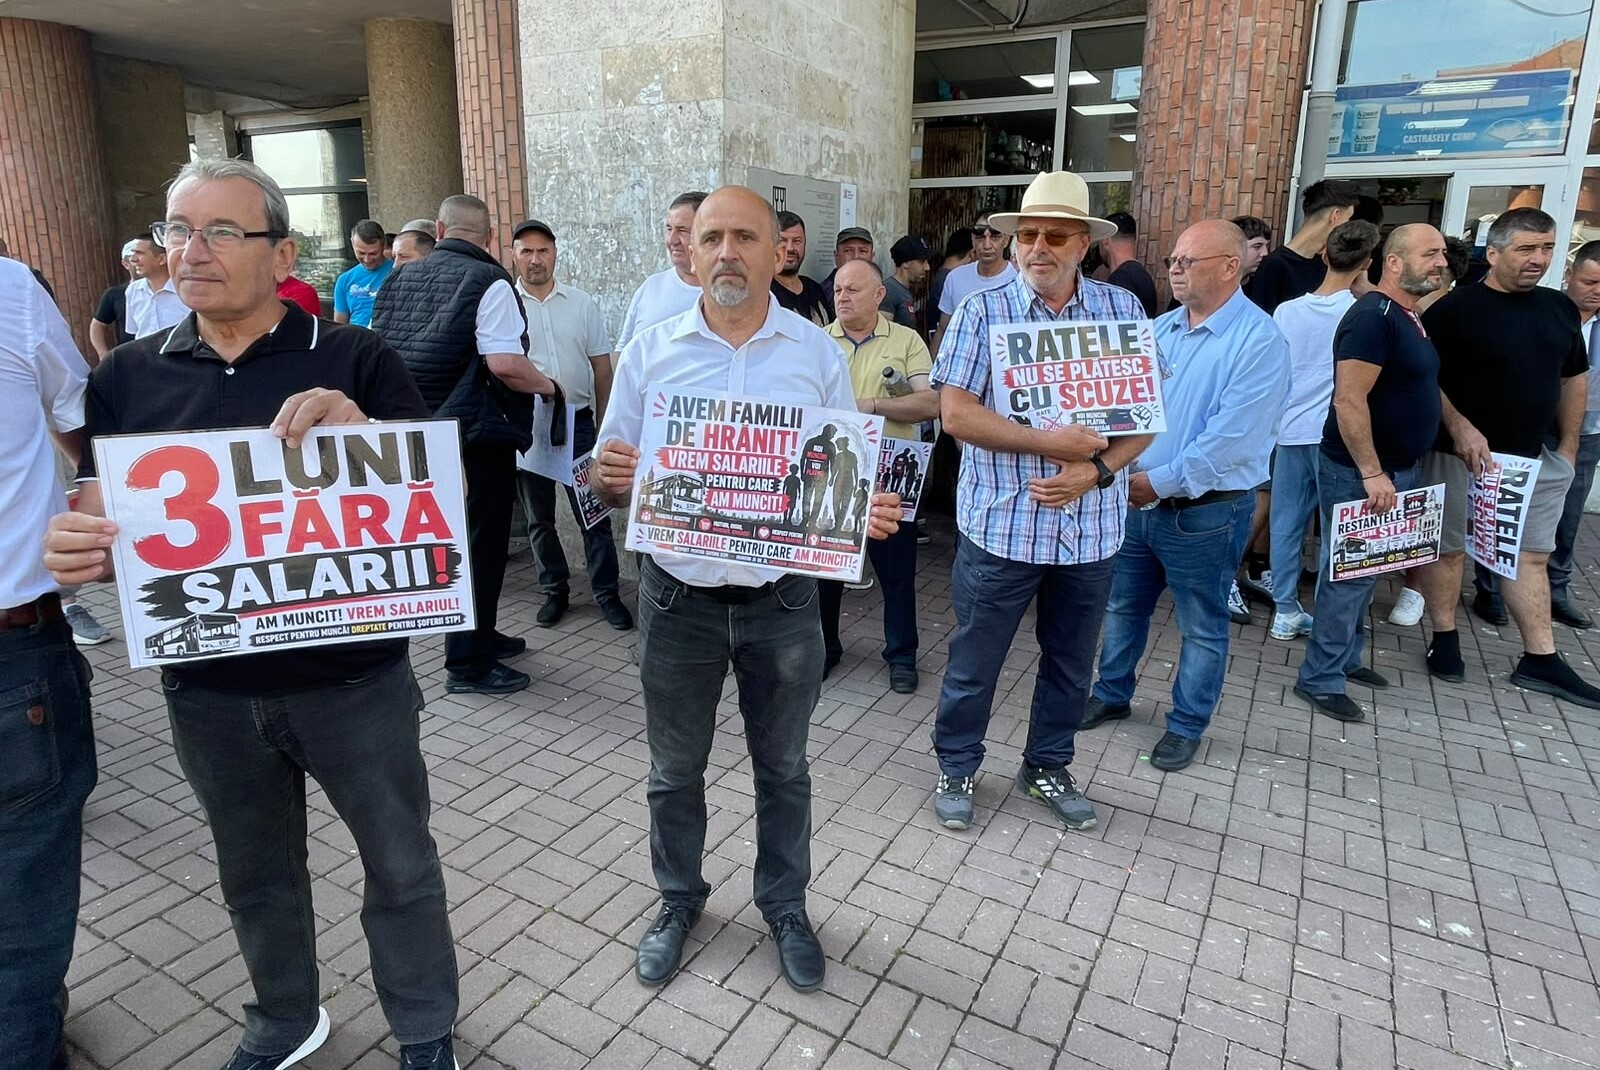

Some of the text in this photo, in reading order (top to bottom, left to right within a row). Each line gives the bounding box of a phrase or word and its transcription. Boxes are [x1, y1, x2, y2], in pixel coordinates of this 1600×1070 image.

[1007, 323, 1142, 366] RATELE
[1012, 357, 1144, 387] NU SE PLĂTESC
[1009, 376, 1156, 413] CU SCUZE!
[668, 395, 803, 429] AVEM FAMILII
[666, 420, 799, 457] DE HRĂNIT!
[228, 430, 430, 498] LUNI
[668, 449, 783, 476] VREM SALARIILE
[706, 473, 746, 490] PENTRU
[748, 476, 774, 492] CARE
[1484, 488, 1496, 505] SE
[125, 445, 454, 571] 3 FĂRĂ
[709, 492, 783, 513] AM MUNCIT!
[1496, 468, 1530, 568] RATELE
[1379, 520, 1411, 538] STP!
[647, 526, 675, 543] VREM
[677, 531, 727, 550] SALARIILE
[729, 538, 765, 555] PENTRU
[766, 544, 791, 560] CARE
[794, 548, 810, 562] AM
[812, 551, 853, 568] MUNCIT!
[182, 546, 450, 615] SALARII!
[255, 597, 460, 631] AM MUNCIT! VREM SALARIUL!
[255, 633, 290, 645] RESPECT
[290, 630, 320, 641] PENTRU
[320, 626, 350, 637] MUNCĂ!
[351, 623, 387, 635] DREPTATE
[387, 620, 416, 632] PENTRU
[444, 614, 462, 625] STP!
